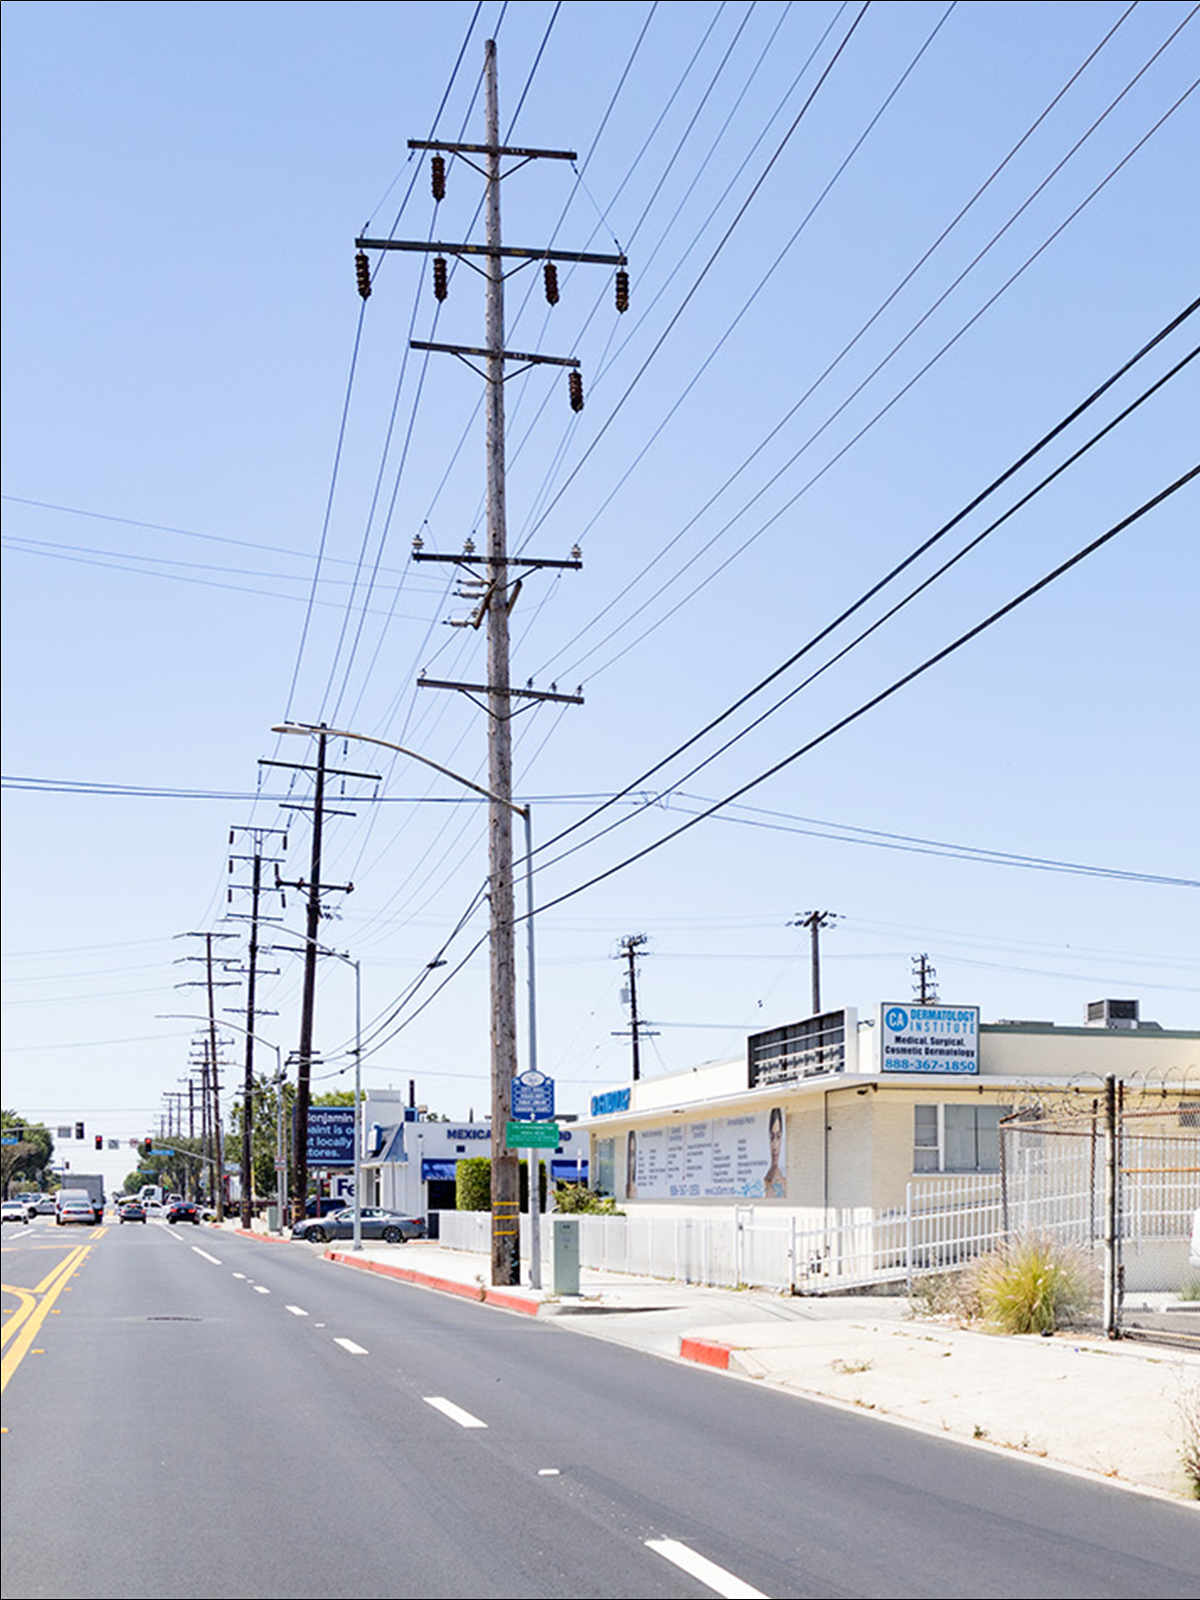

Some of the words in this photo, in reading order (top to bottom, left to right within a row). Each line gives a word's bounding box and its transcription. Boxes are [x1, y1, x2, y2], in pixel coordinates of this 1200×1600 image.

[888, 1011, 905, 1027] CA
[910, 1008, 975, 1022] DERMATOLOGY
[910, 1022, 975, 1034] INSTITUTE
[885, 1046, 922, 1055] Cosmetic
[924, 1047, 975, 1058] Dermatology
[885, 1058, 975, 1071] 888-367-1850
[308, 1112, 354, 1125] enjamin
[307, 1125, 332, 1134] aint
[333, 1125, 343, 1134] is
[446, 1129, 492, 1140] MEXICA
[316, 1136, 353, 1149] locally
[307, 1148, 341, 1157] tores.
